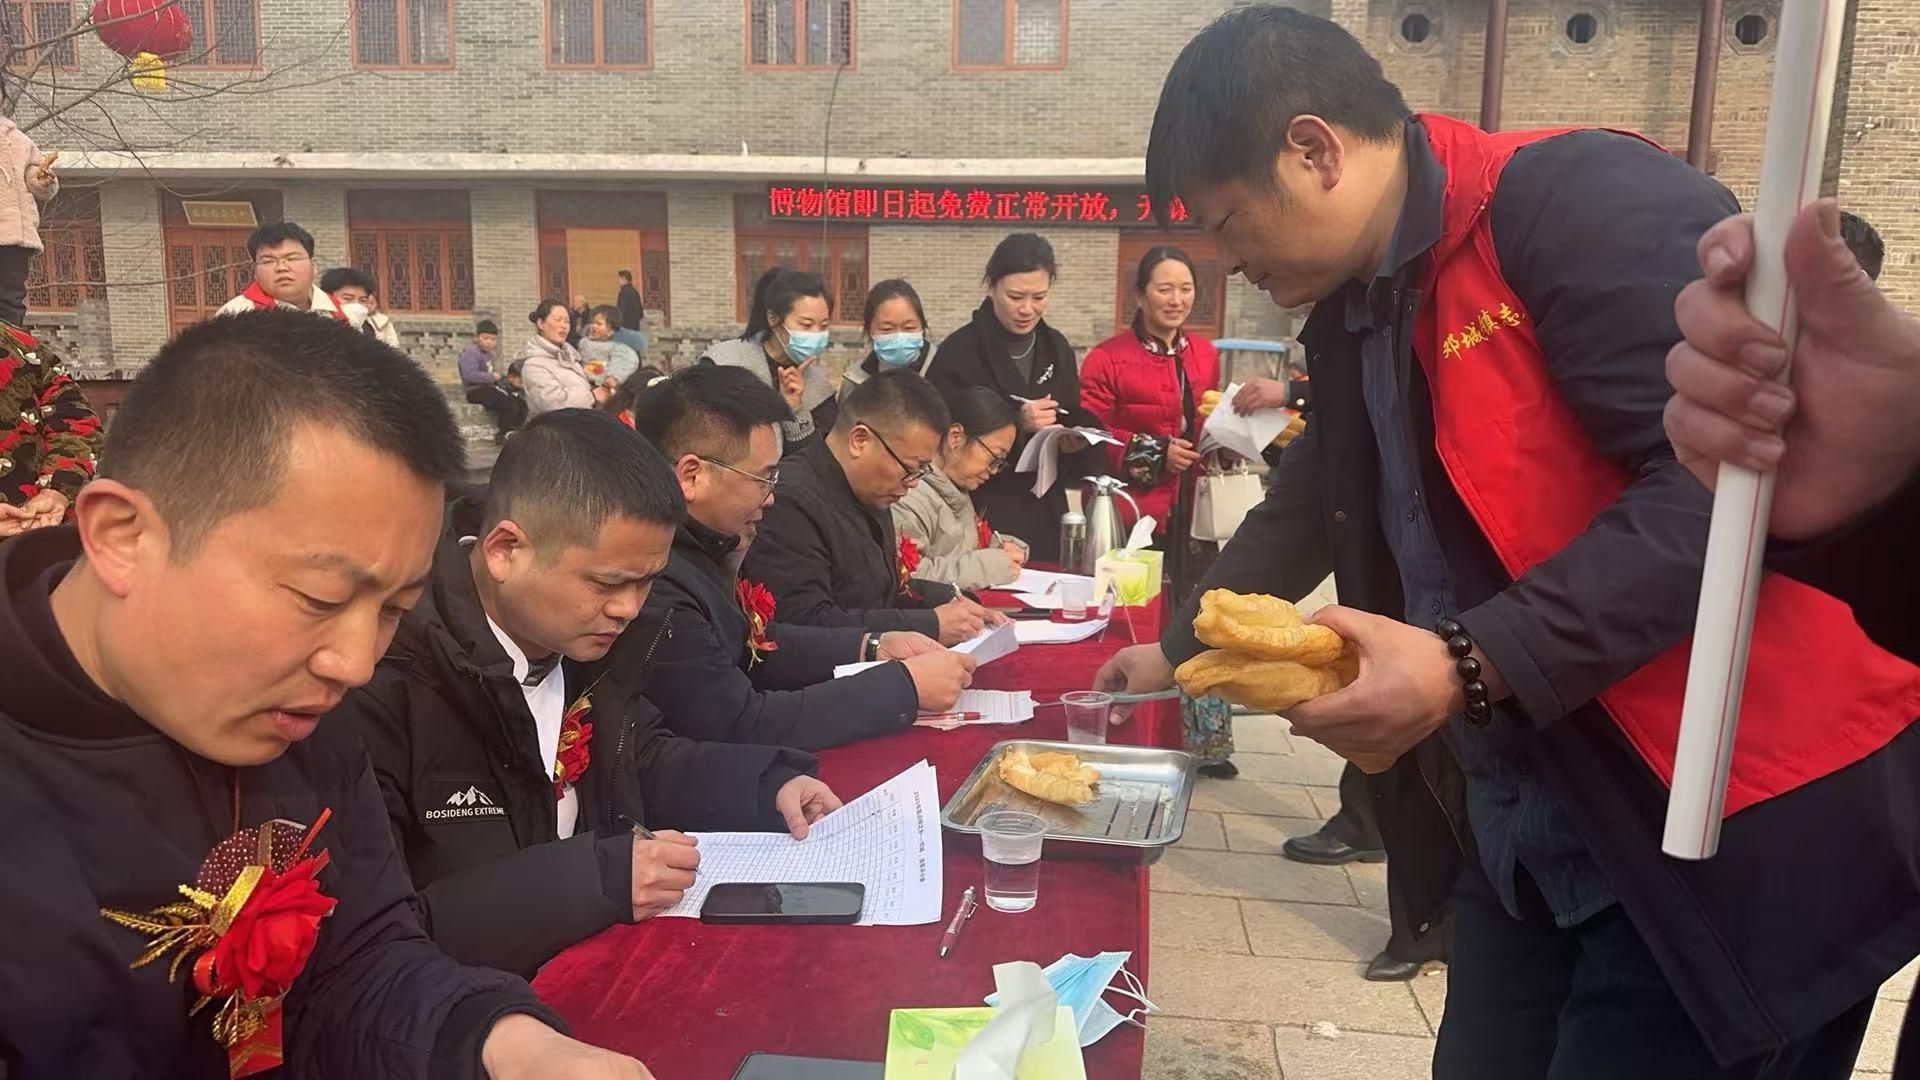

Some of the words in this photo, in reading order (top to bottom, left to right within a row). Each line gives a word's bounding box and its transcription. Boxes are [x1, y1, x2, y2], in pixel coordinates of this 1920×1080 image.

[1442, 302, 1528, 360] 邓城镇志
[425, 808, 474, 819] BOSIDENG
[474, 807, 505, 816] EXTREME
